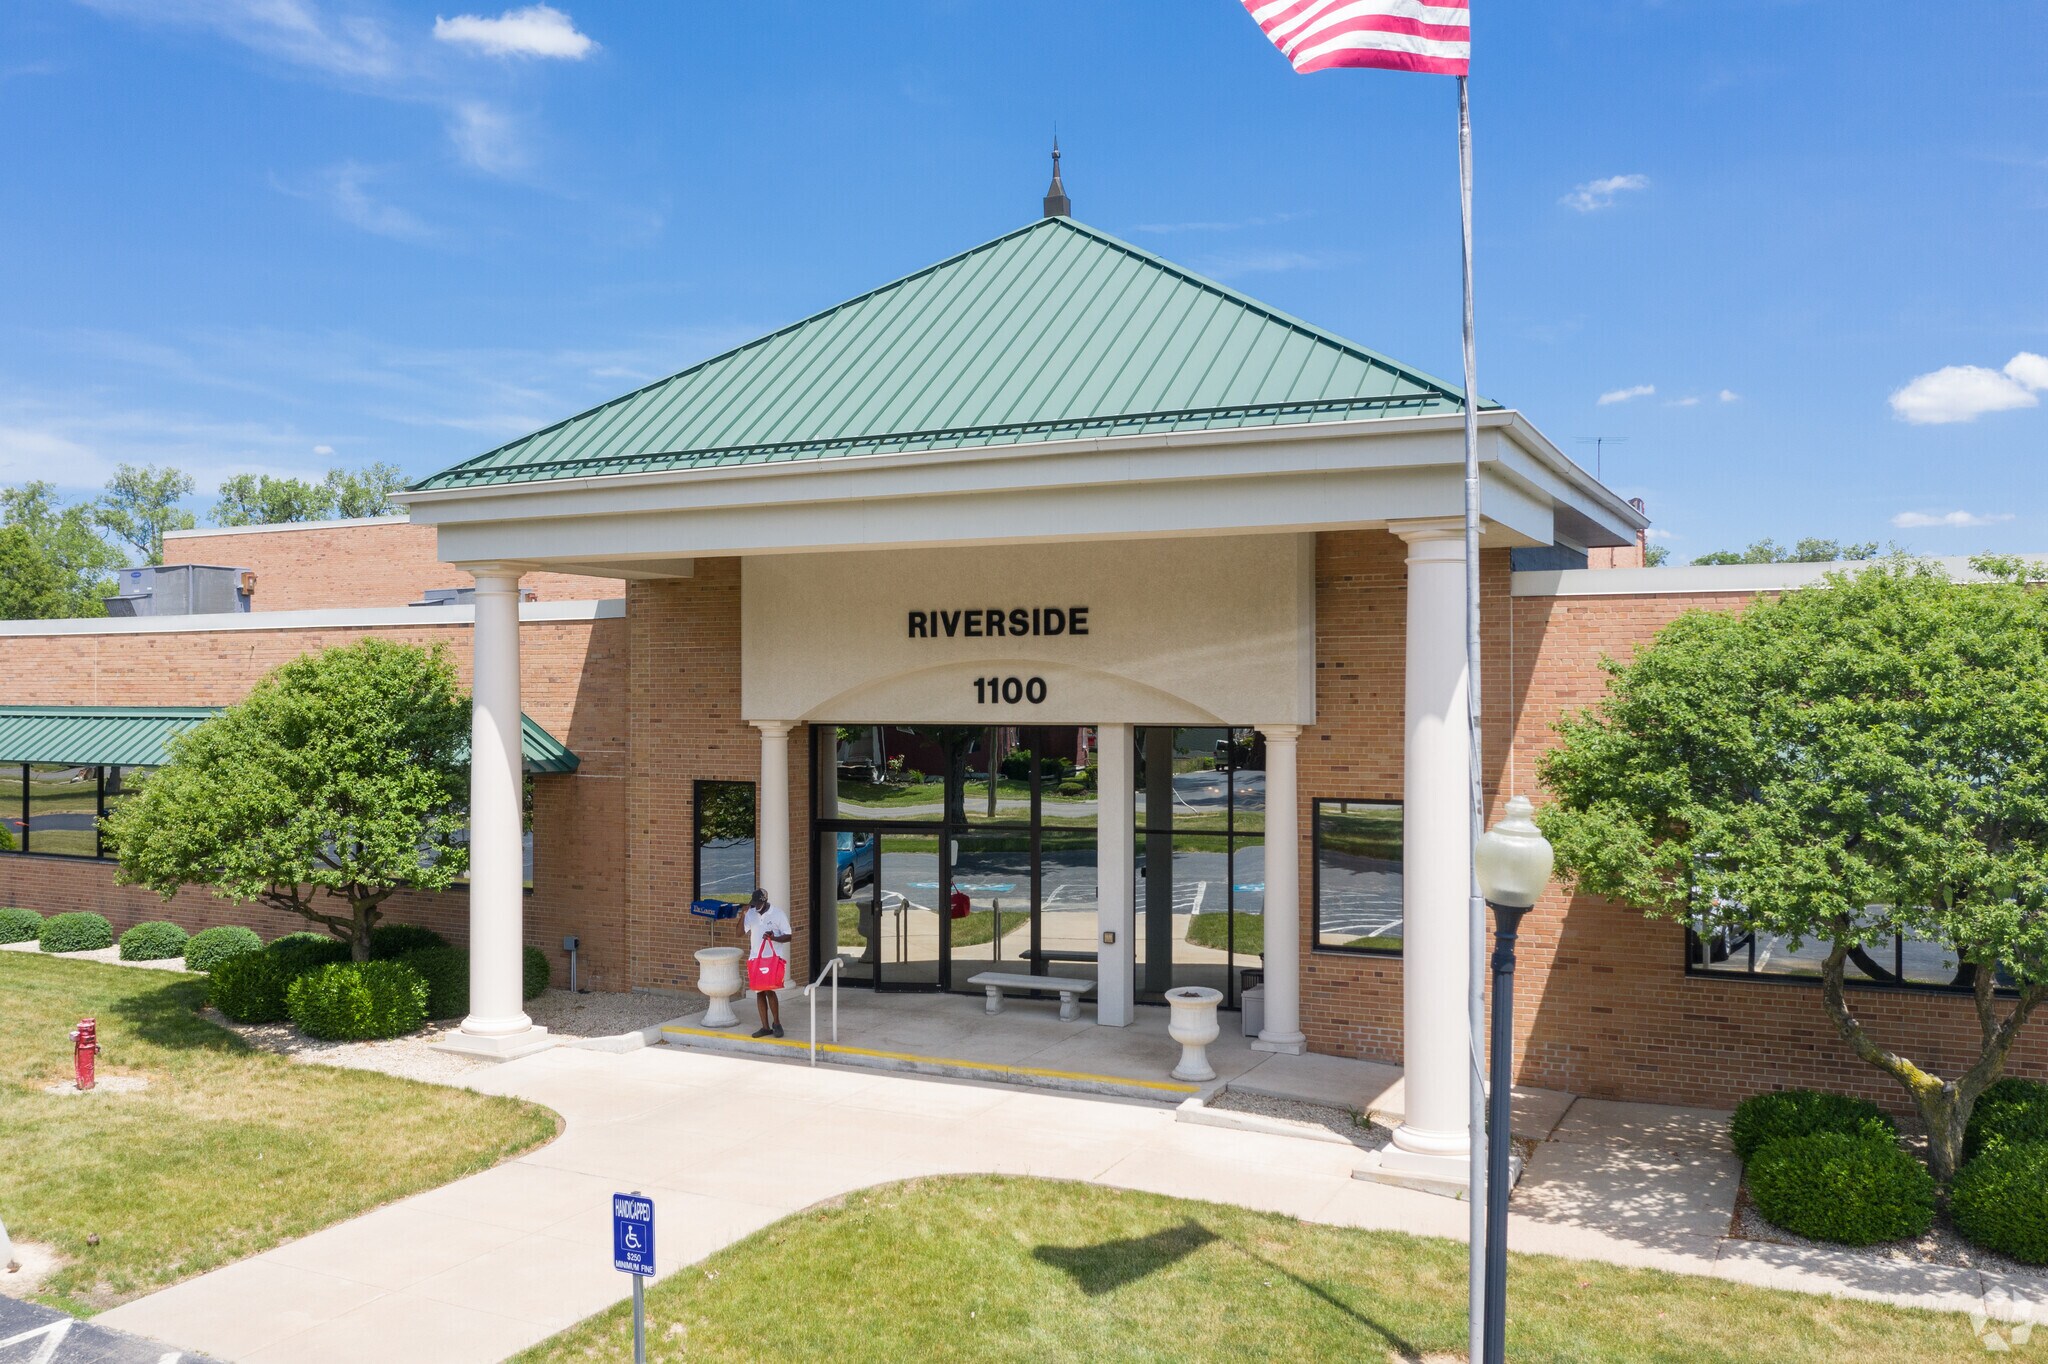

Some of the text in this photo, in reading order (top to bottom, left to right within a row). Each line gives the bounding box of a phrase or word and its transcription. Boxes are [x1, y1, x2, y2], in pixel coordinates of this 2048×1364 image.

[908, 607, 1089, 638] RIVERSIDE
[973, 677, 1047, 704] 1100
[615, 1199, 650, 1221] HANDICAPPED
[616, 1260, 653, 1273] MINIMUM FINE
[627, 1252, 641, 1262] $250
